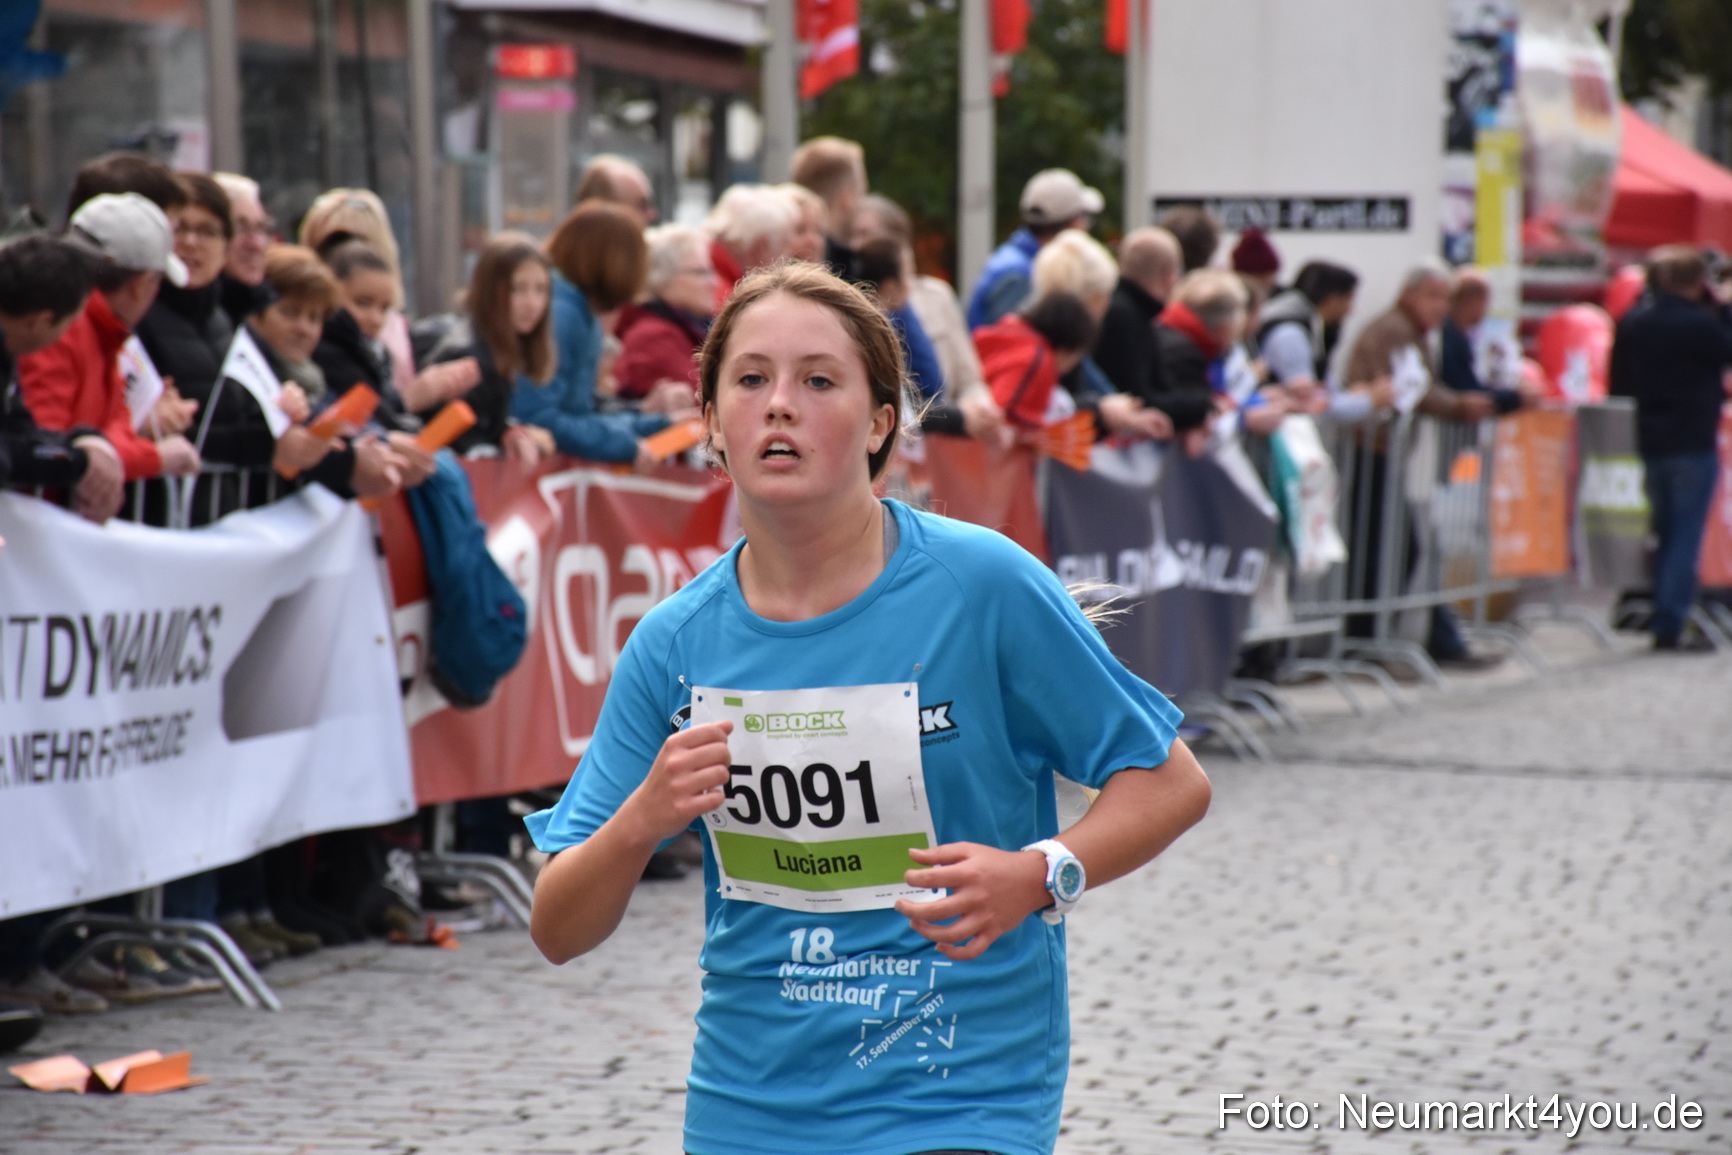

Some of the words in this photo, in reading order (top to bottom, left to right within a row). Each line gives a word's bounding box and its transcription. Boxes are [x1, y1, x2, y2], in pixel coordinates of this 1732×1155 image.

[767, 711, 846, 732] BOCK
[723, 760, 880, 829] 5091
[774, 848, 862, 875] Luciana
[779, 954, 921, 977] Neumarkter
[780, 978, 888, 1011] Stadtlauf
[855, 1055, 873, 1070] 17.
[869, 1014, 922, 1059] September
[920, 993, 945, 1019] 2017
